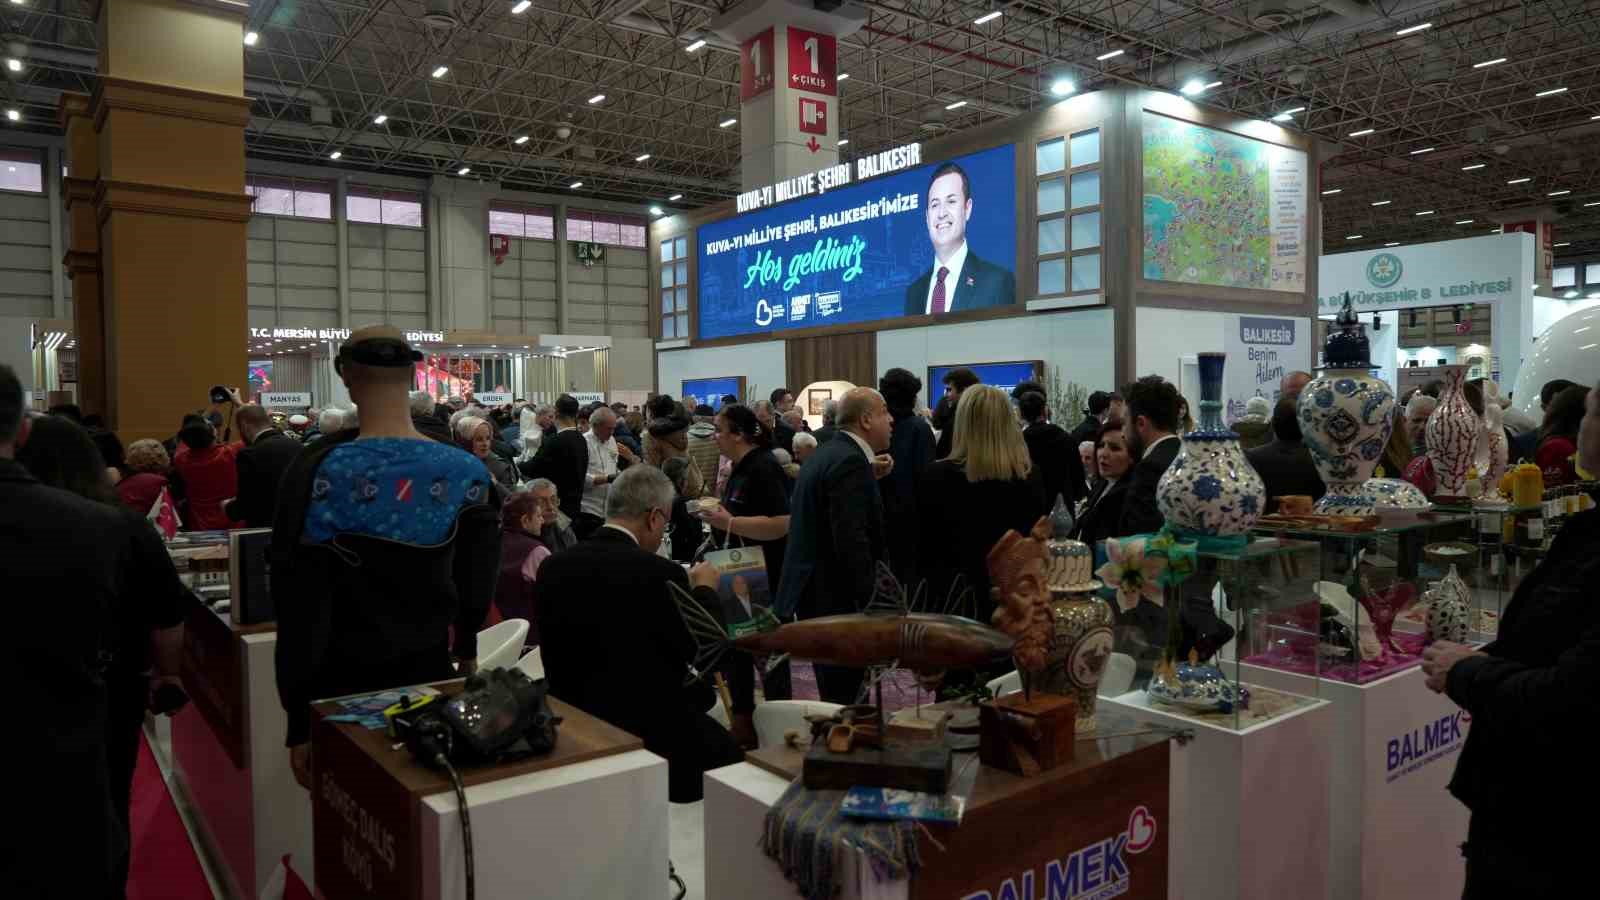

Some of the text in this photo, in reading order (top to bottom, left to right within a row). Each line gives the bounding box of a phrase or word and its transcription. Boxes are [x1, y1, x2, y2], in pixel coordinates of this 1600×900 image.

[804, 37, 819, 74] 1
[817, 163, 850, 194] ŞEHRİ
[857, 142, 920, 180] BALIKESİR
[744, 225, 782, 248] MİLLİYE
[784, 214, 818, 241] ŞEHRİ,
[783, 235, 866, 292] geldiniz
[251, 328, 271, 338] T.C.
[273, 327, 316, 339] MERSİN
[319, 328, 352, 339] BÜYÜ
[1243, 325, 1292, 343] BALIKESİR
[1248, 347, 1277, 360] Benim
[1387, 711, 1461, 771] BALMEK
[960, 831, 1129, 900] ALMEK
